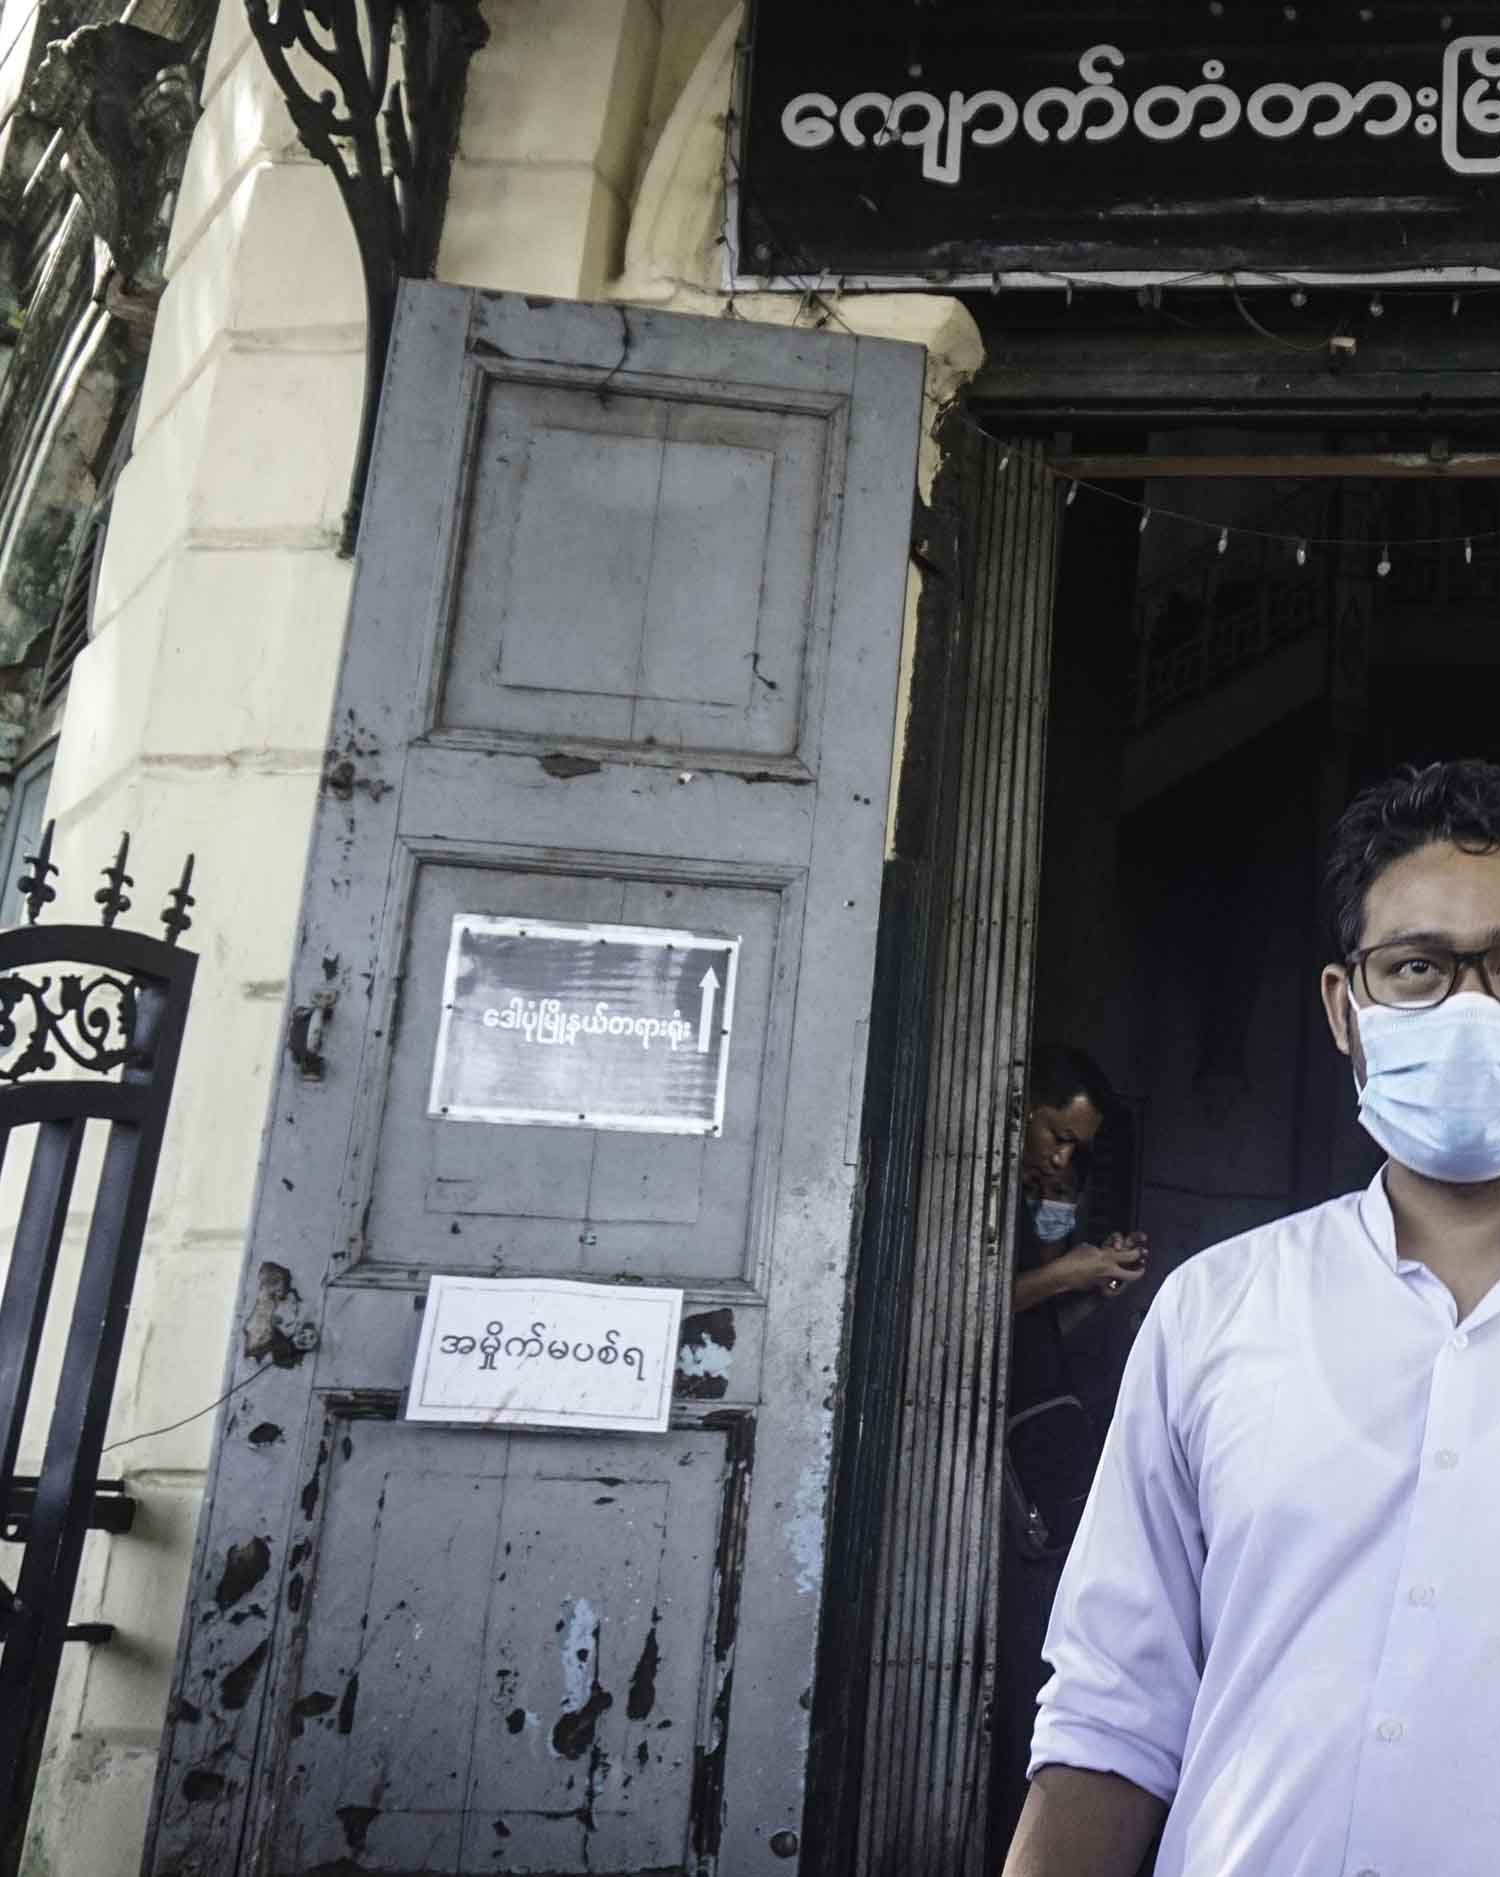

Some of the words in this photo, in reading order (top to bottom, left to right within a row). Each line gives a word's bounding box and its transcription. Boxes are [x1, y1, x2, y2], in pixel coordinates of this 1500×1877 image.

[440, 1321, 646, 1380] အမှိုက်မပစ်ရ
